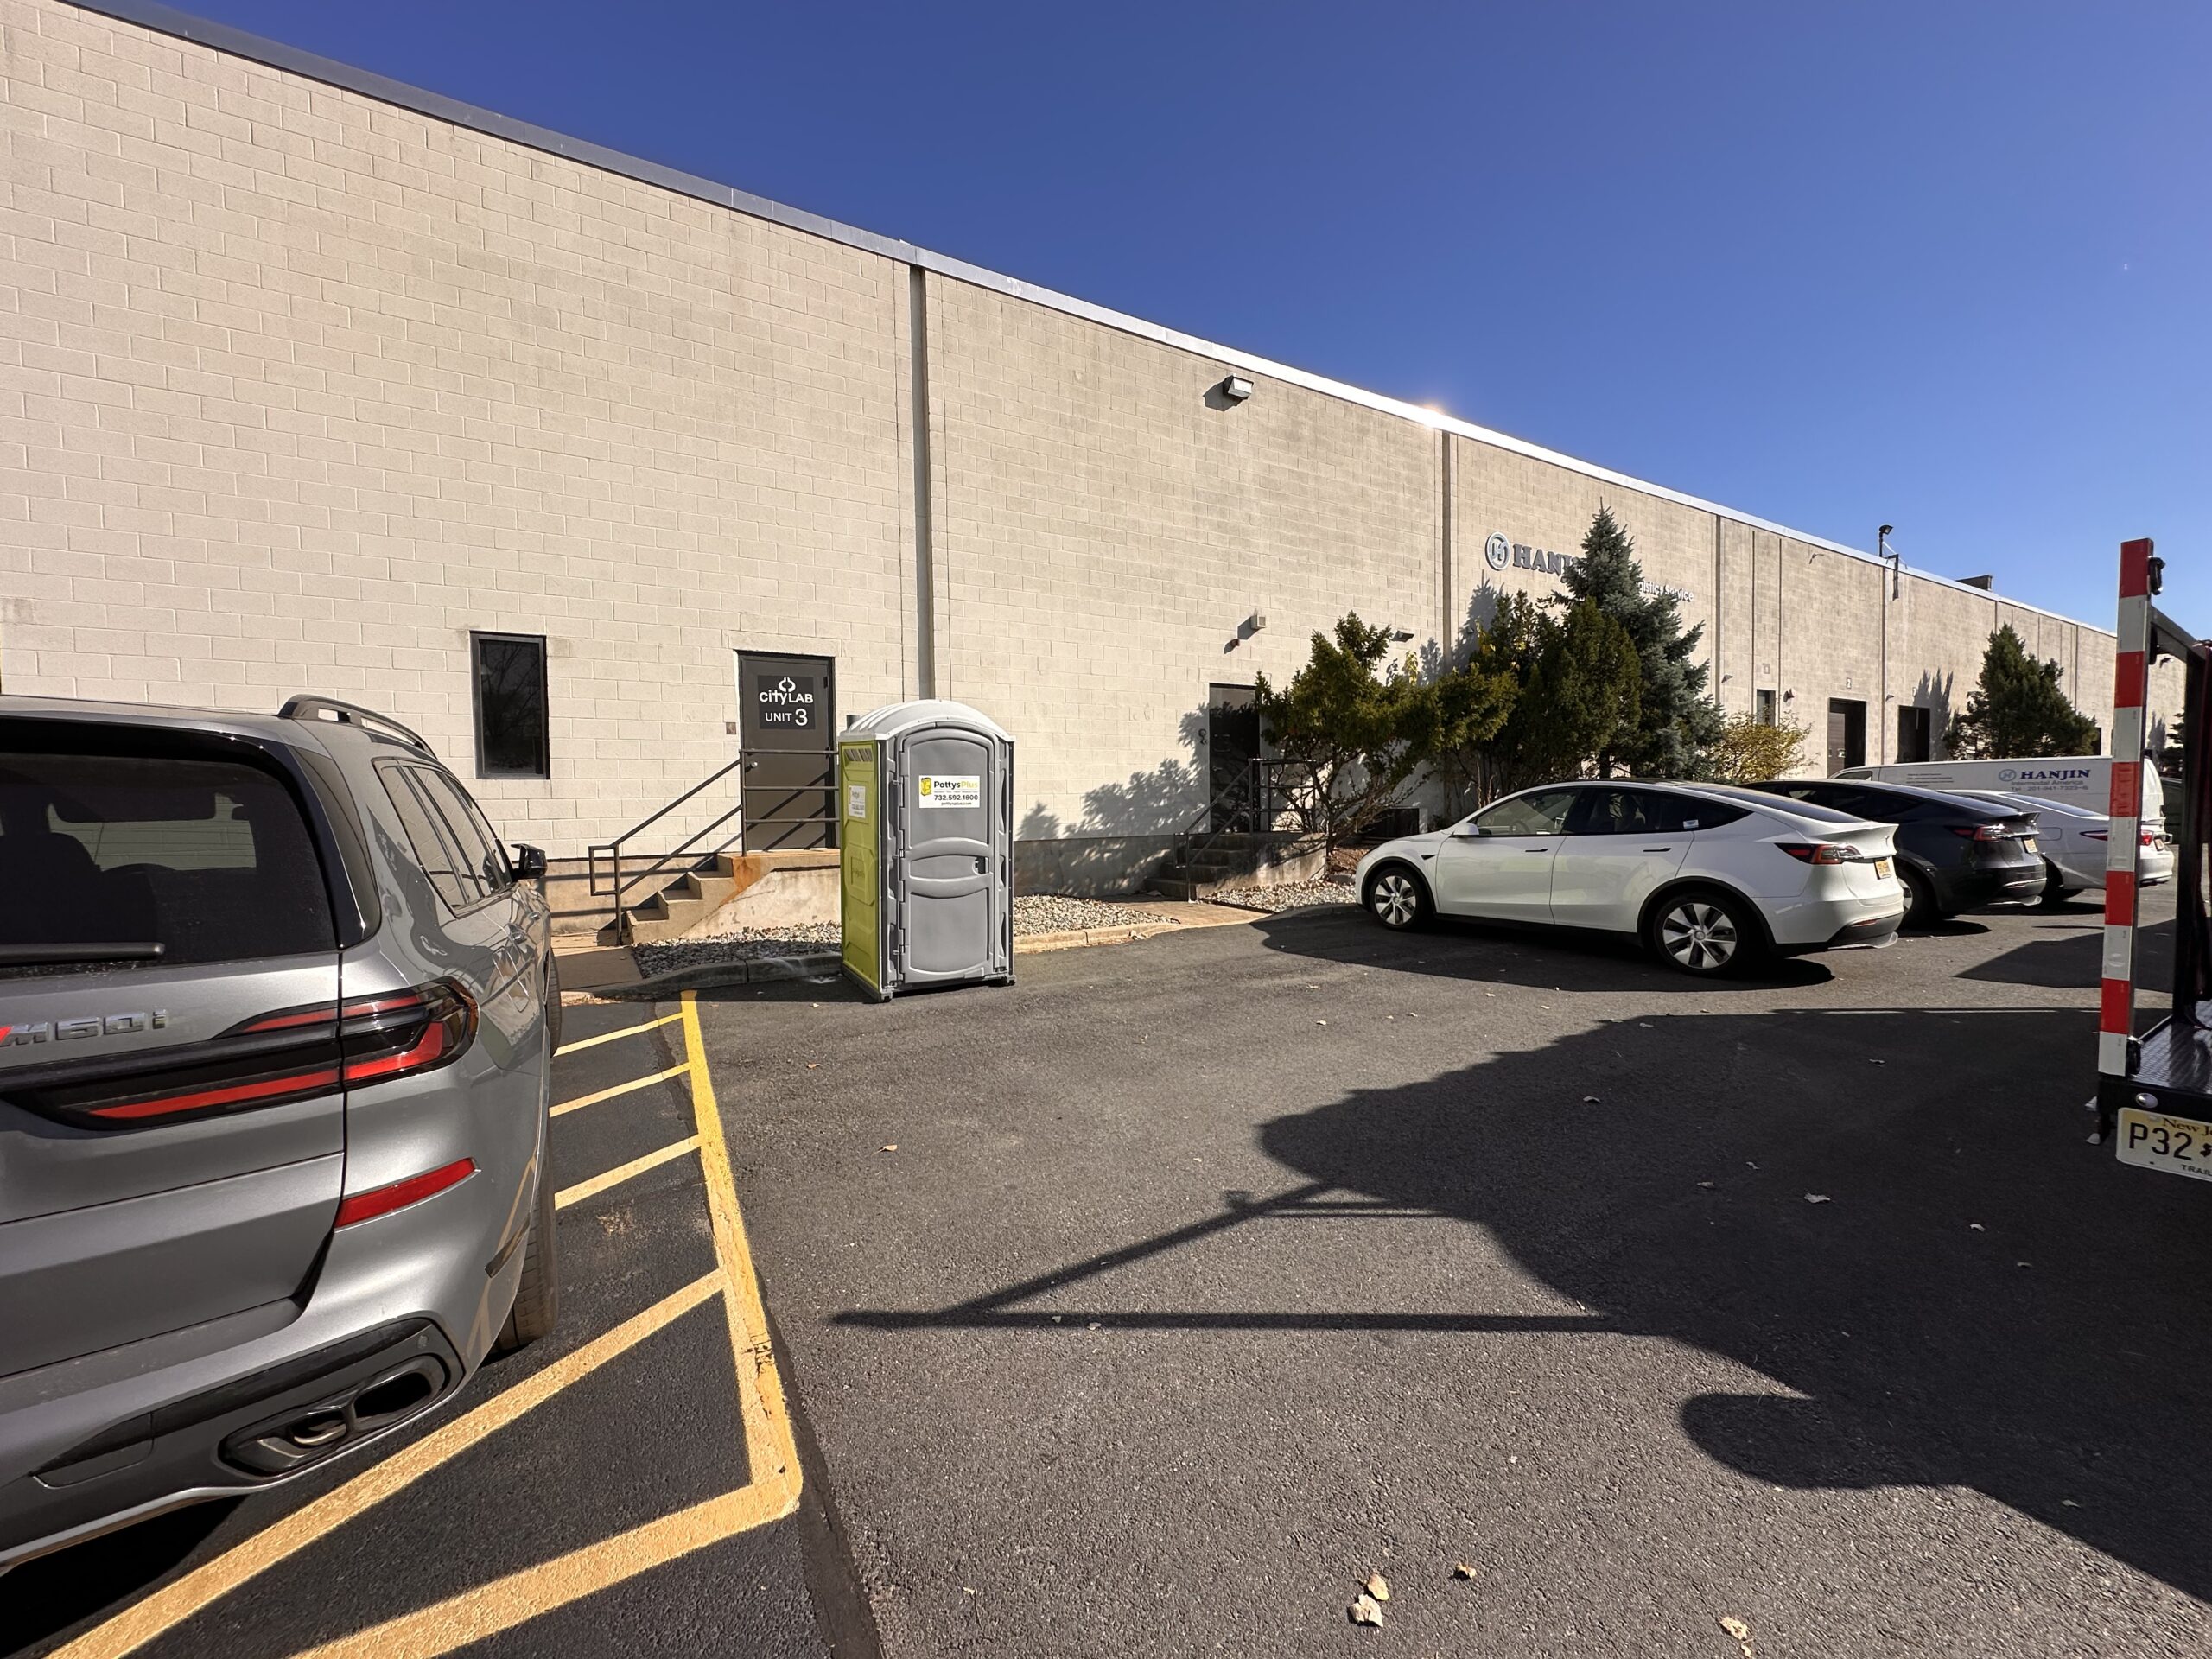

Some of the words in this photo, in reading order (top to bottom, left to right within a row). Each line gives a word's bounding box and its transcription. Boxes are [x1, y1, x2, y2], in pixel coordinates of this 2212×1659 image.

[1513, 543, 1580, 576] HAN
[759, 690, 814, 705] cityLAB
[765, 712, 792, 722] UNIT
[795, 708, 808, 726] 3
[2020, 769, 2090, 780] HANJIN
[933, 781, 978, 790] PottysPlus
[2163, 1116, 2200, 1132] New
[2129, 1122, 2193, 1160] P32
